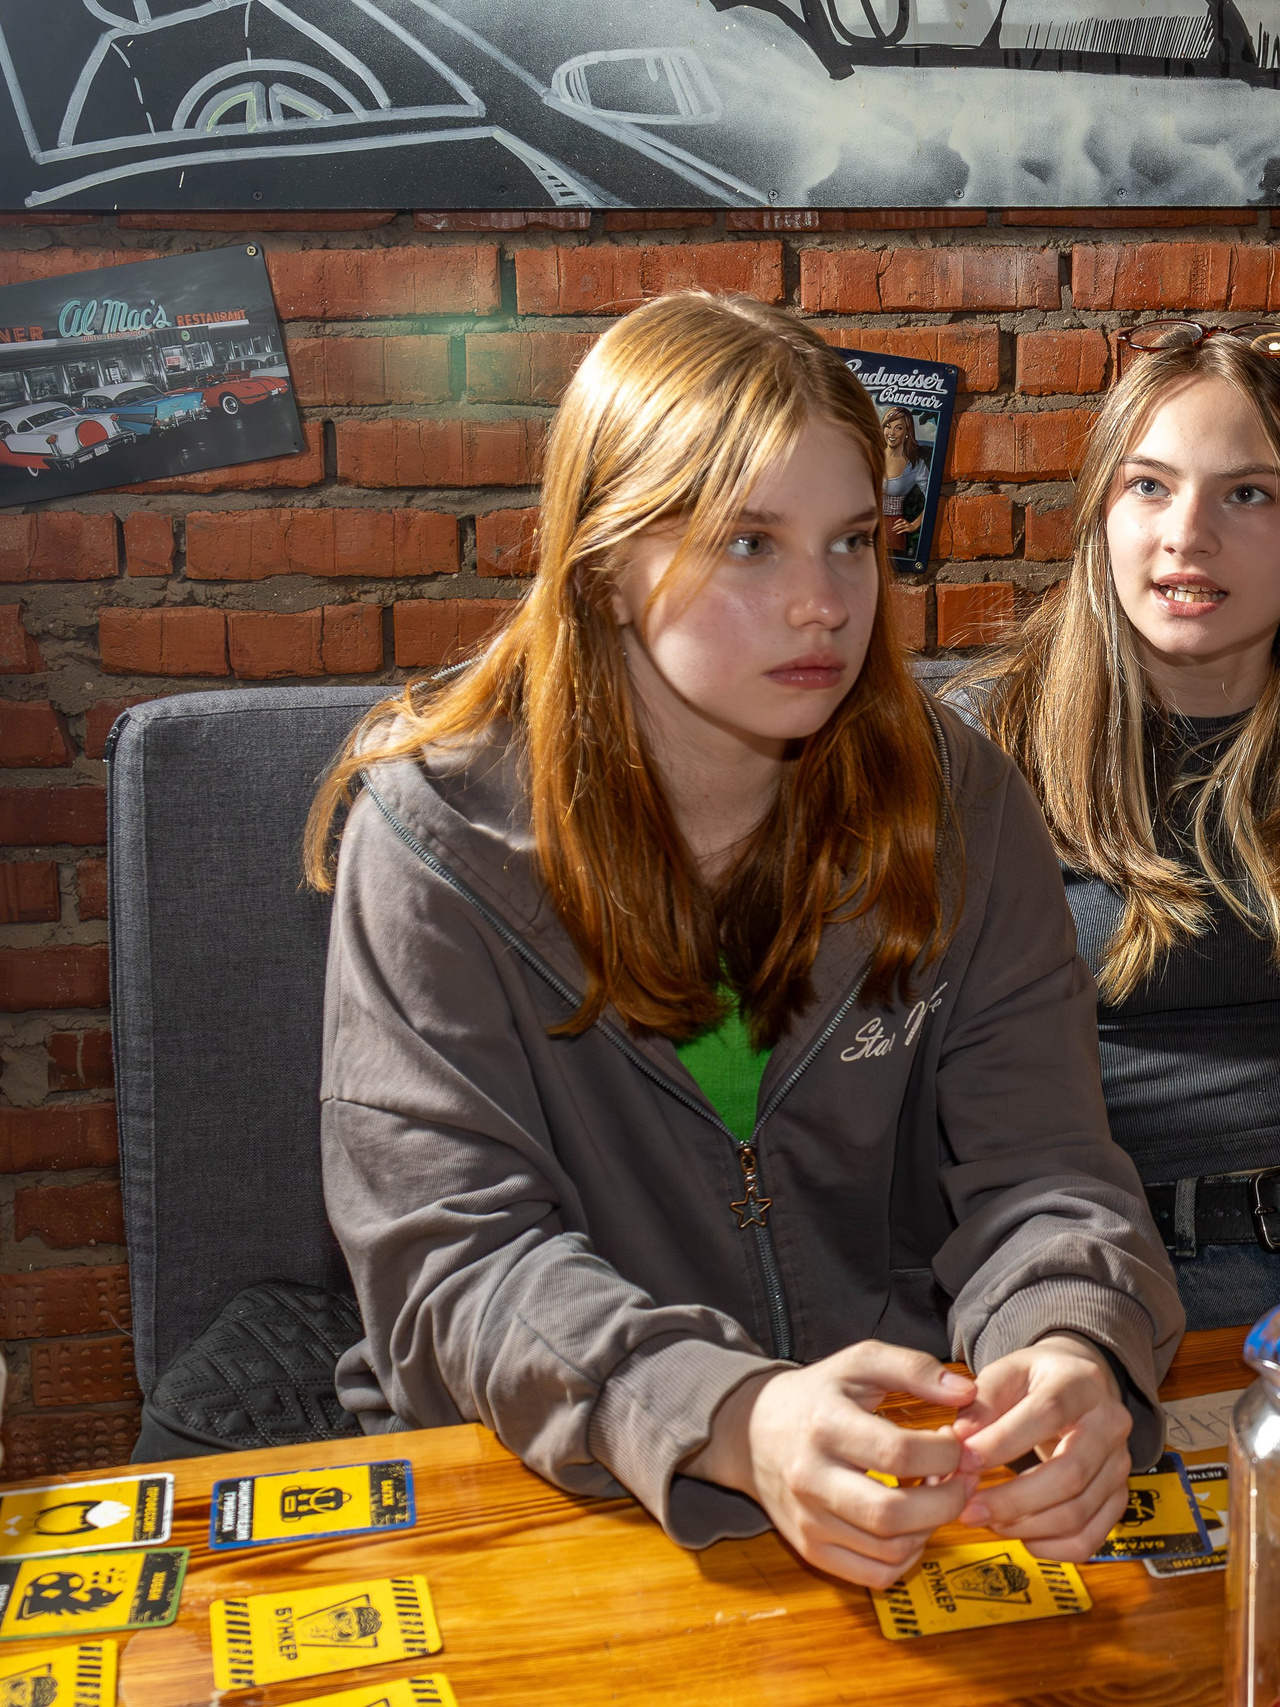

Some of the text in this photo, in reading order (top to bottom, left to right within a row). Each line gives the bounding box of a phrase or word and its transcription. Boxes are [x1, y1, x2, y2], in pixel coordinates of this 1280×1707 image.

[102, 299, 173, 335] Mac's
[175, 308, 247, 327] RESTAURANT
[879, 384, 943, 408] Budvar
[381, 1479, 395, 1507] БАГАЖ
[1112, 1539, 1167, 1552] БАГАЖ
[921, 1561, 958, 1614] БУНКЕР
[274, 1606, 299, 1662] БУНКЕР
